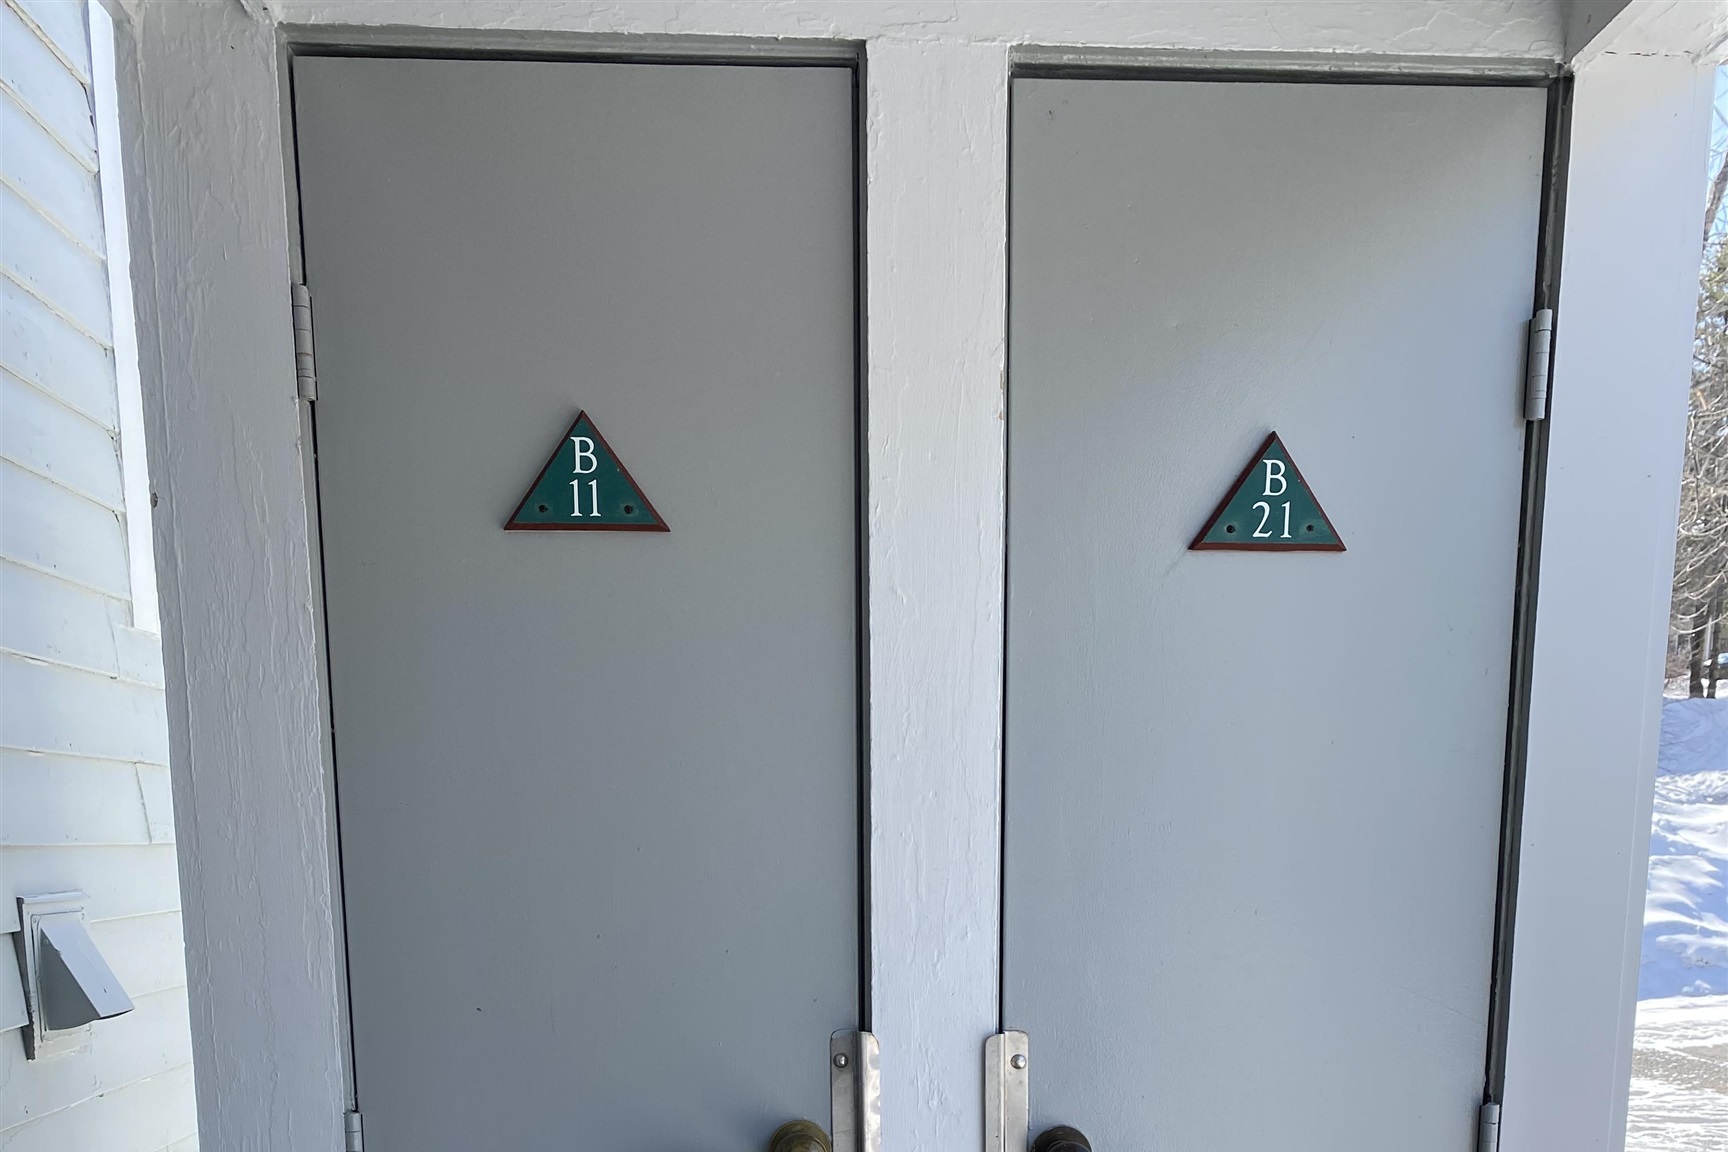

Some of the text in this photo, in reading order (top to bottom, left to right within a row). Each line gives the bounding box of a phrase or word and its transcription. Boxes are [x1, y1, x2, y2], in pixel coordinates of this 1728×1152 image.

[569, 436, 598, 474] B
[1262, 459, 1288, 496] B
[568, 478, 602, 517] 11
[1252, 501, 1292, 538] 21
